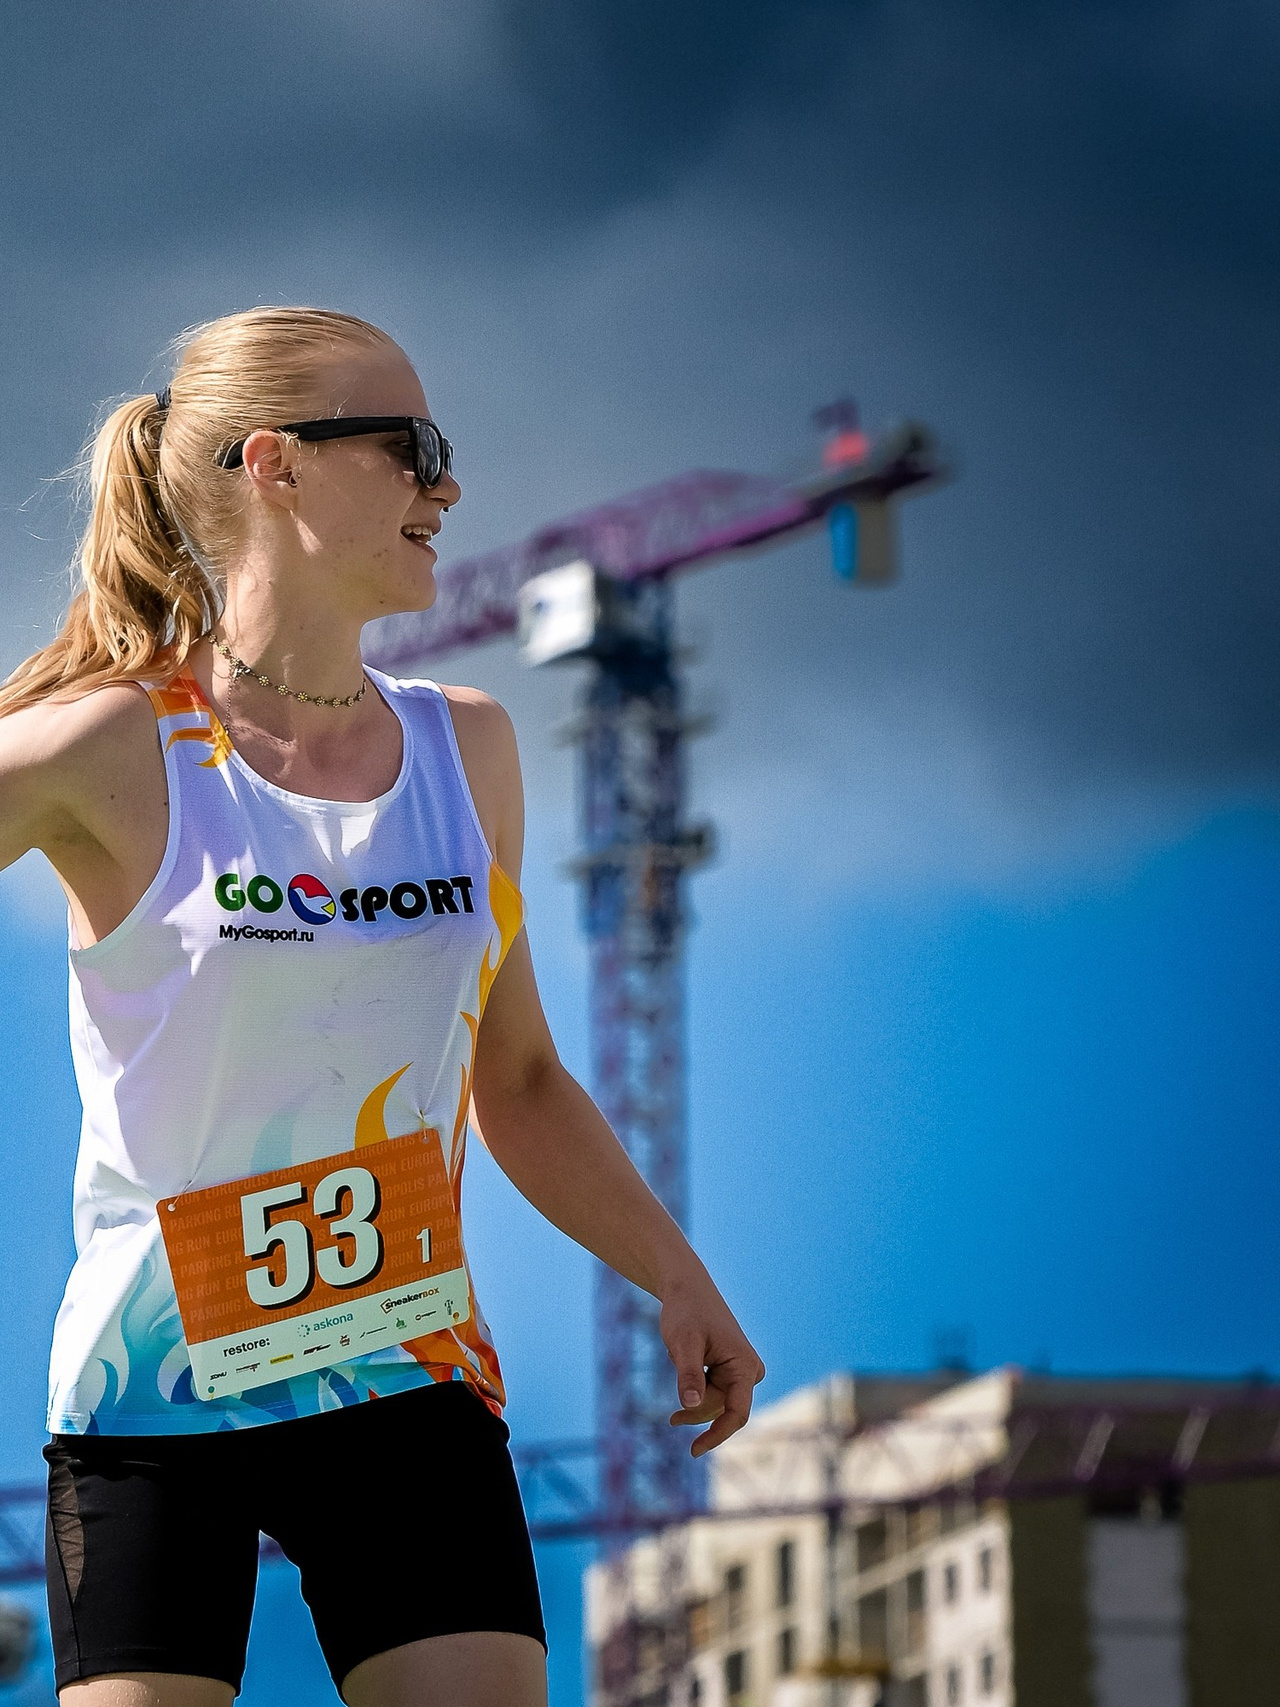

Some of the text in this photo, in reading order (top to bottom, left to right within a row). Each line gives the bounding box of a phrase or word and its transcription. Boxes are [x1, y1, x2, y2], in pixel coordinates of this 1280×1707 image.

[215, 873, 475, 922] GO SPORT
[219, 925, 314, 942] MyGosport.ru
[169, 1208, 221, 1232] PARKING
[382, 1206, 406, 1223] RUN
[187, 1234, 211, 1252] RUN
[240, 1167, 380, 1308] 53
[417, 1228, 431, 1264] 1
[180, 1253, 231, 1278] PARKING
[196, 1280, 220, 1297] RUN
[190, 1298, 241, 1323] PARKING
[223, 1337, 270, 1357] restore:
[313, 1312, 354, 1331] askona
